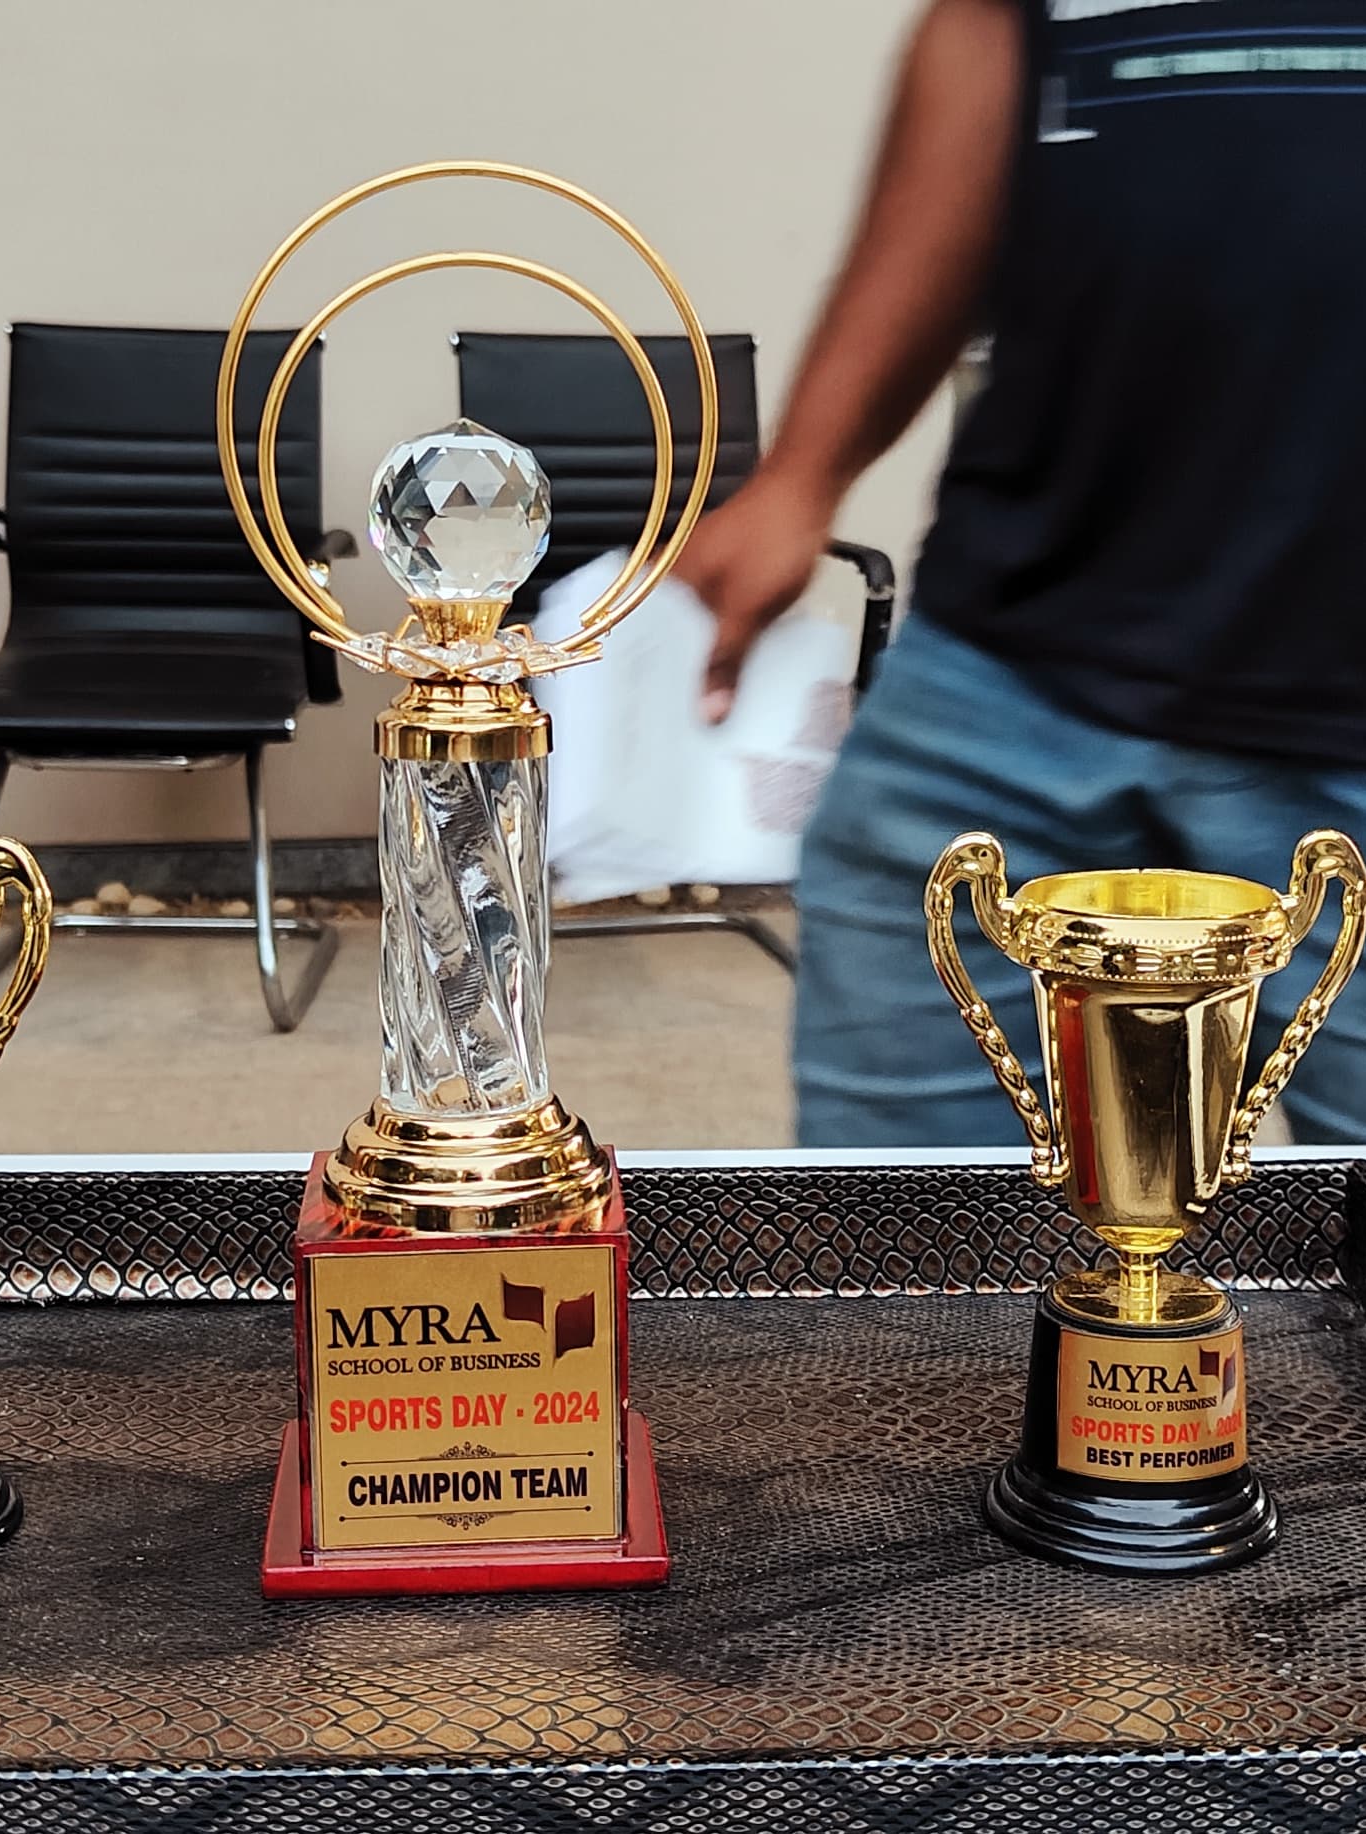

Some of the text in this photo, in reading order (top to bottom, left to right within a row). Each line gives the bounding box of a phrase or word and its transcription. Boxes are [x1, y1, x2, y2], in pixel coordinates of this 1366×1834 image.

[326, 1302, 500, 1350] MYRA
[328, 1352, 540, 1376] SCHOOL OF BUSINESS
[1088, 1360, 1197, 1393] MYRA
[330, 1396, 443, 1433] SPORTS
[453, 1394, 507, 1427] DAY
[533, 1391, 599, 1424] 2024
[1087, 1396, 1217, 1412] SCHOOL OF BUSINESS
[1071, 1415, 1155, 1444] SPORTS
[1163, 1423, 1201, 1444] DAY
[1087, 1442, 1234, 1468] BEST PERFORMER
[348, 1467, 587, 1506] CHAMPION TEAM
